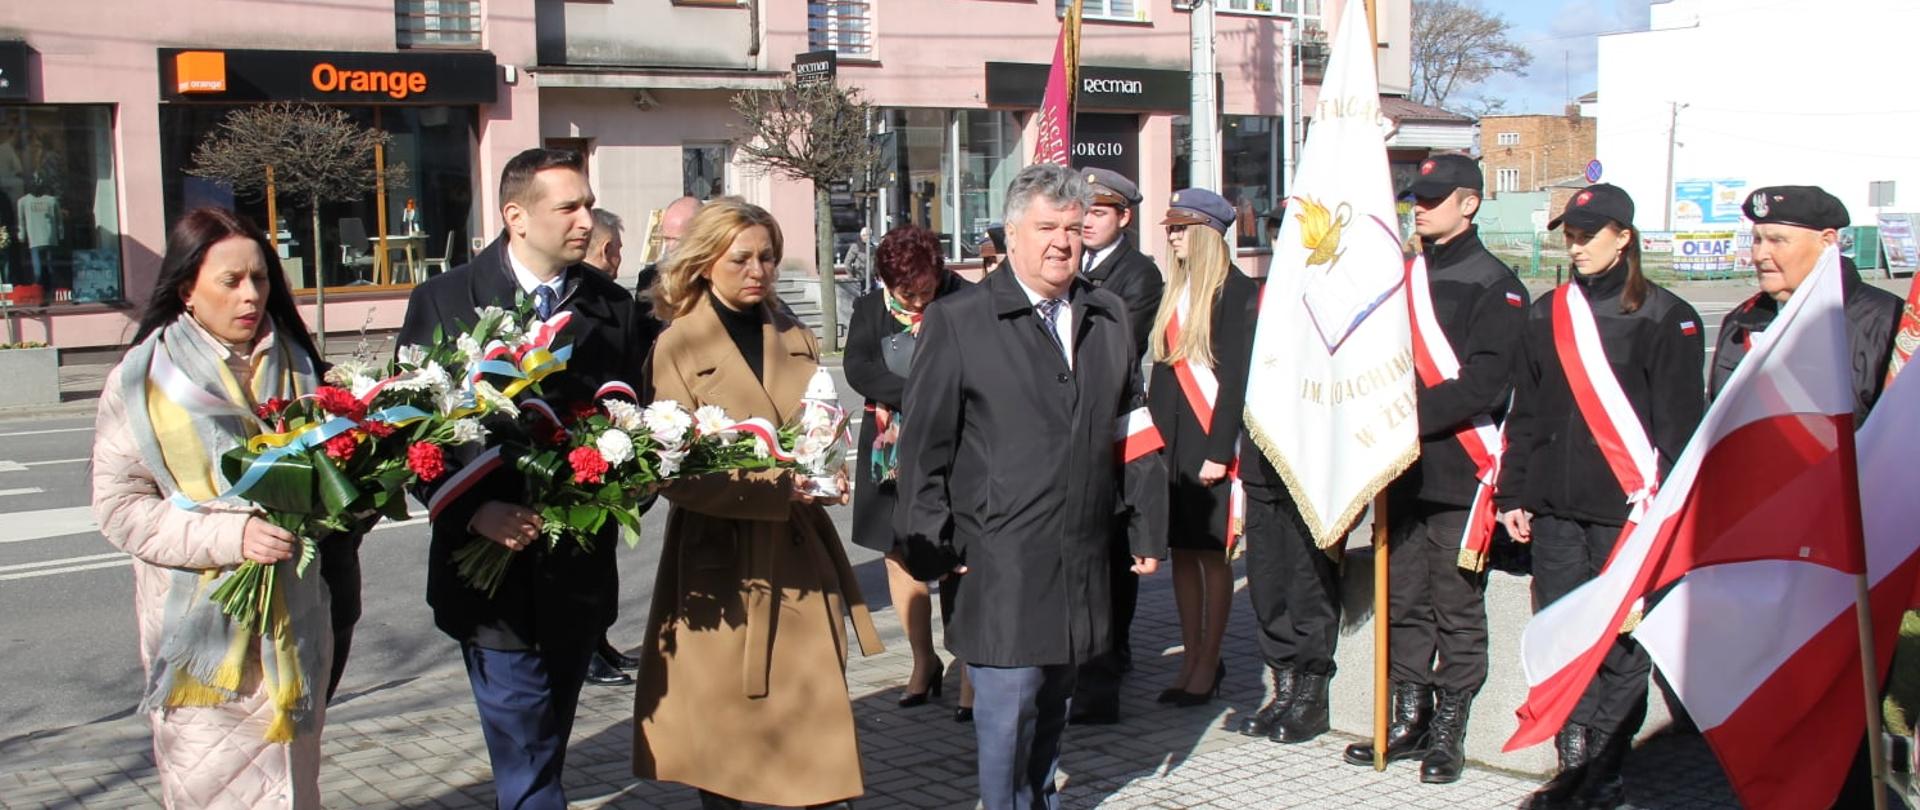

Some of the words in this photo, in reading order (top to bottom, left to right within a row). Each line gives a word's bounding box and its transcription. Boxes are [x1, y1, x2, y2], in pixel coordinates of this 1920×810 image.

[311, 63, 427, 99] Orange
[1083, 78, 1143, 94] Recman
[1047, 105, 1068, 168] LICEU
